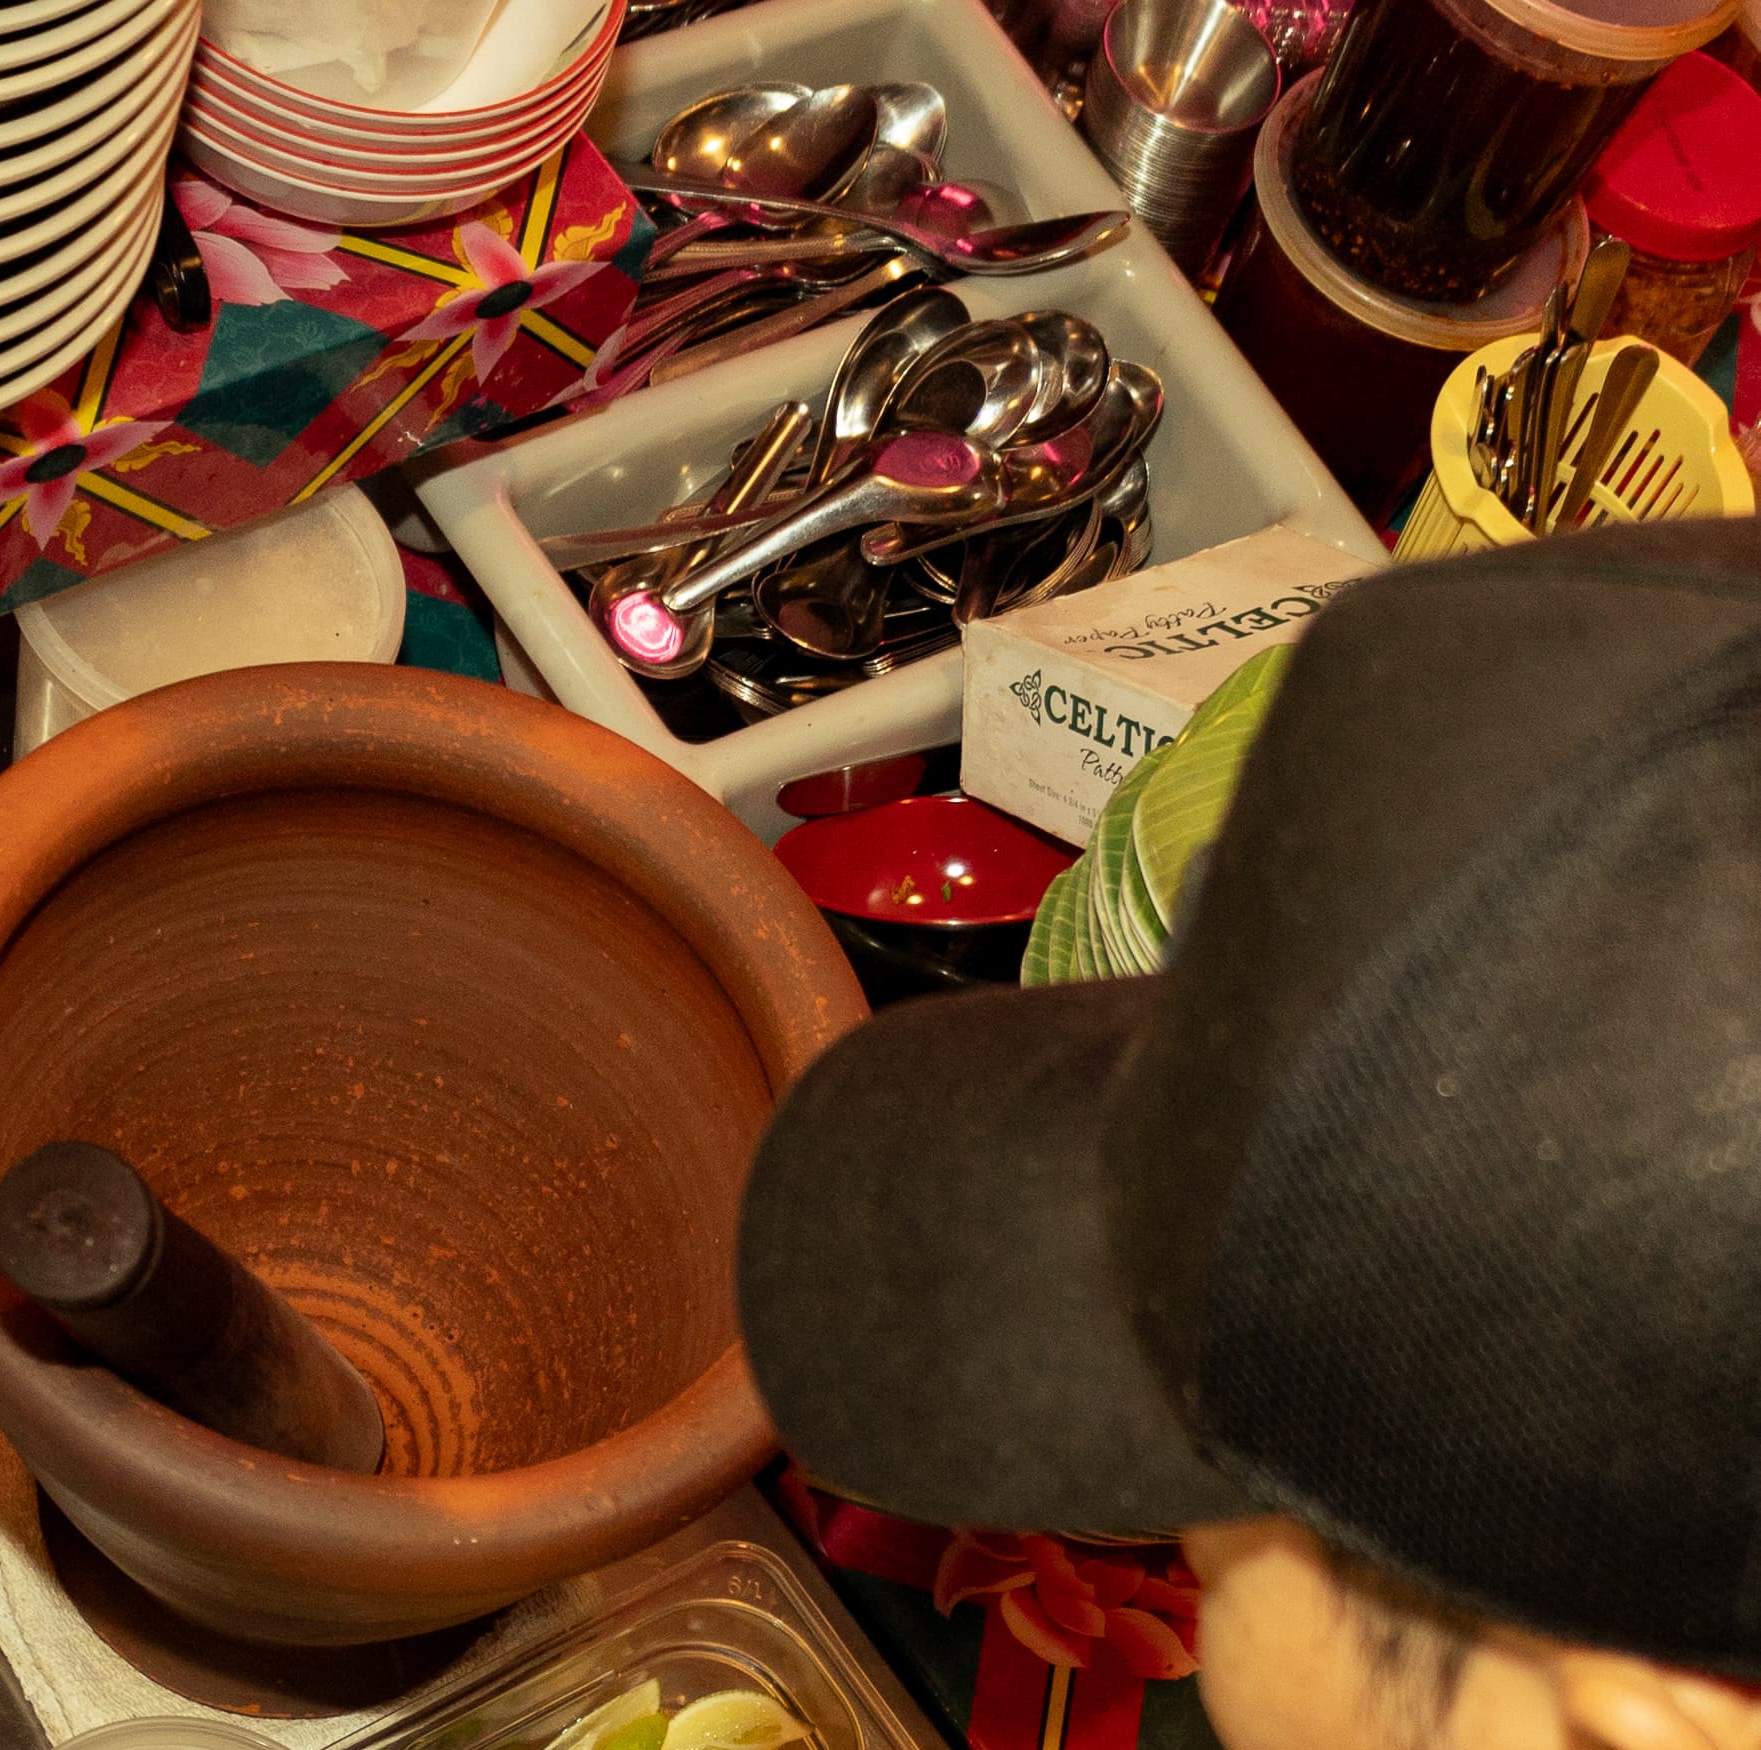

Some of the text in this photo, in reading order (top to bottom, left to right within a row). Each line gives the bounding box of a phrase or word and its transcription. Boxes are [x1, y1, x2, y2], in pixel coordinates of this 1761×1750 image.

[1064, 602, 1227, 645] Patty Paper
[1104, 597, 1321, 660] CELTIC
